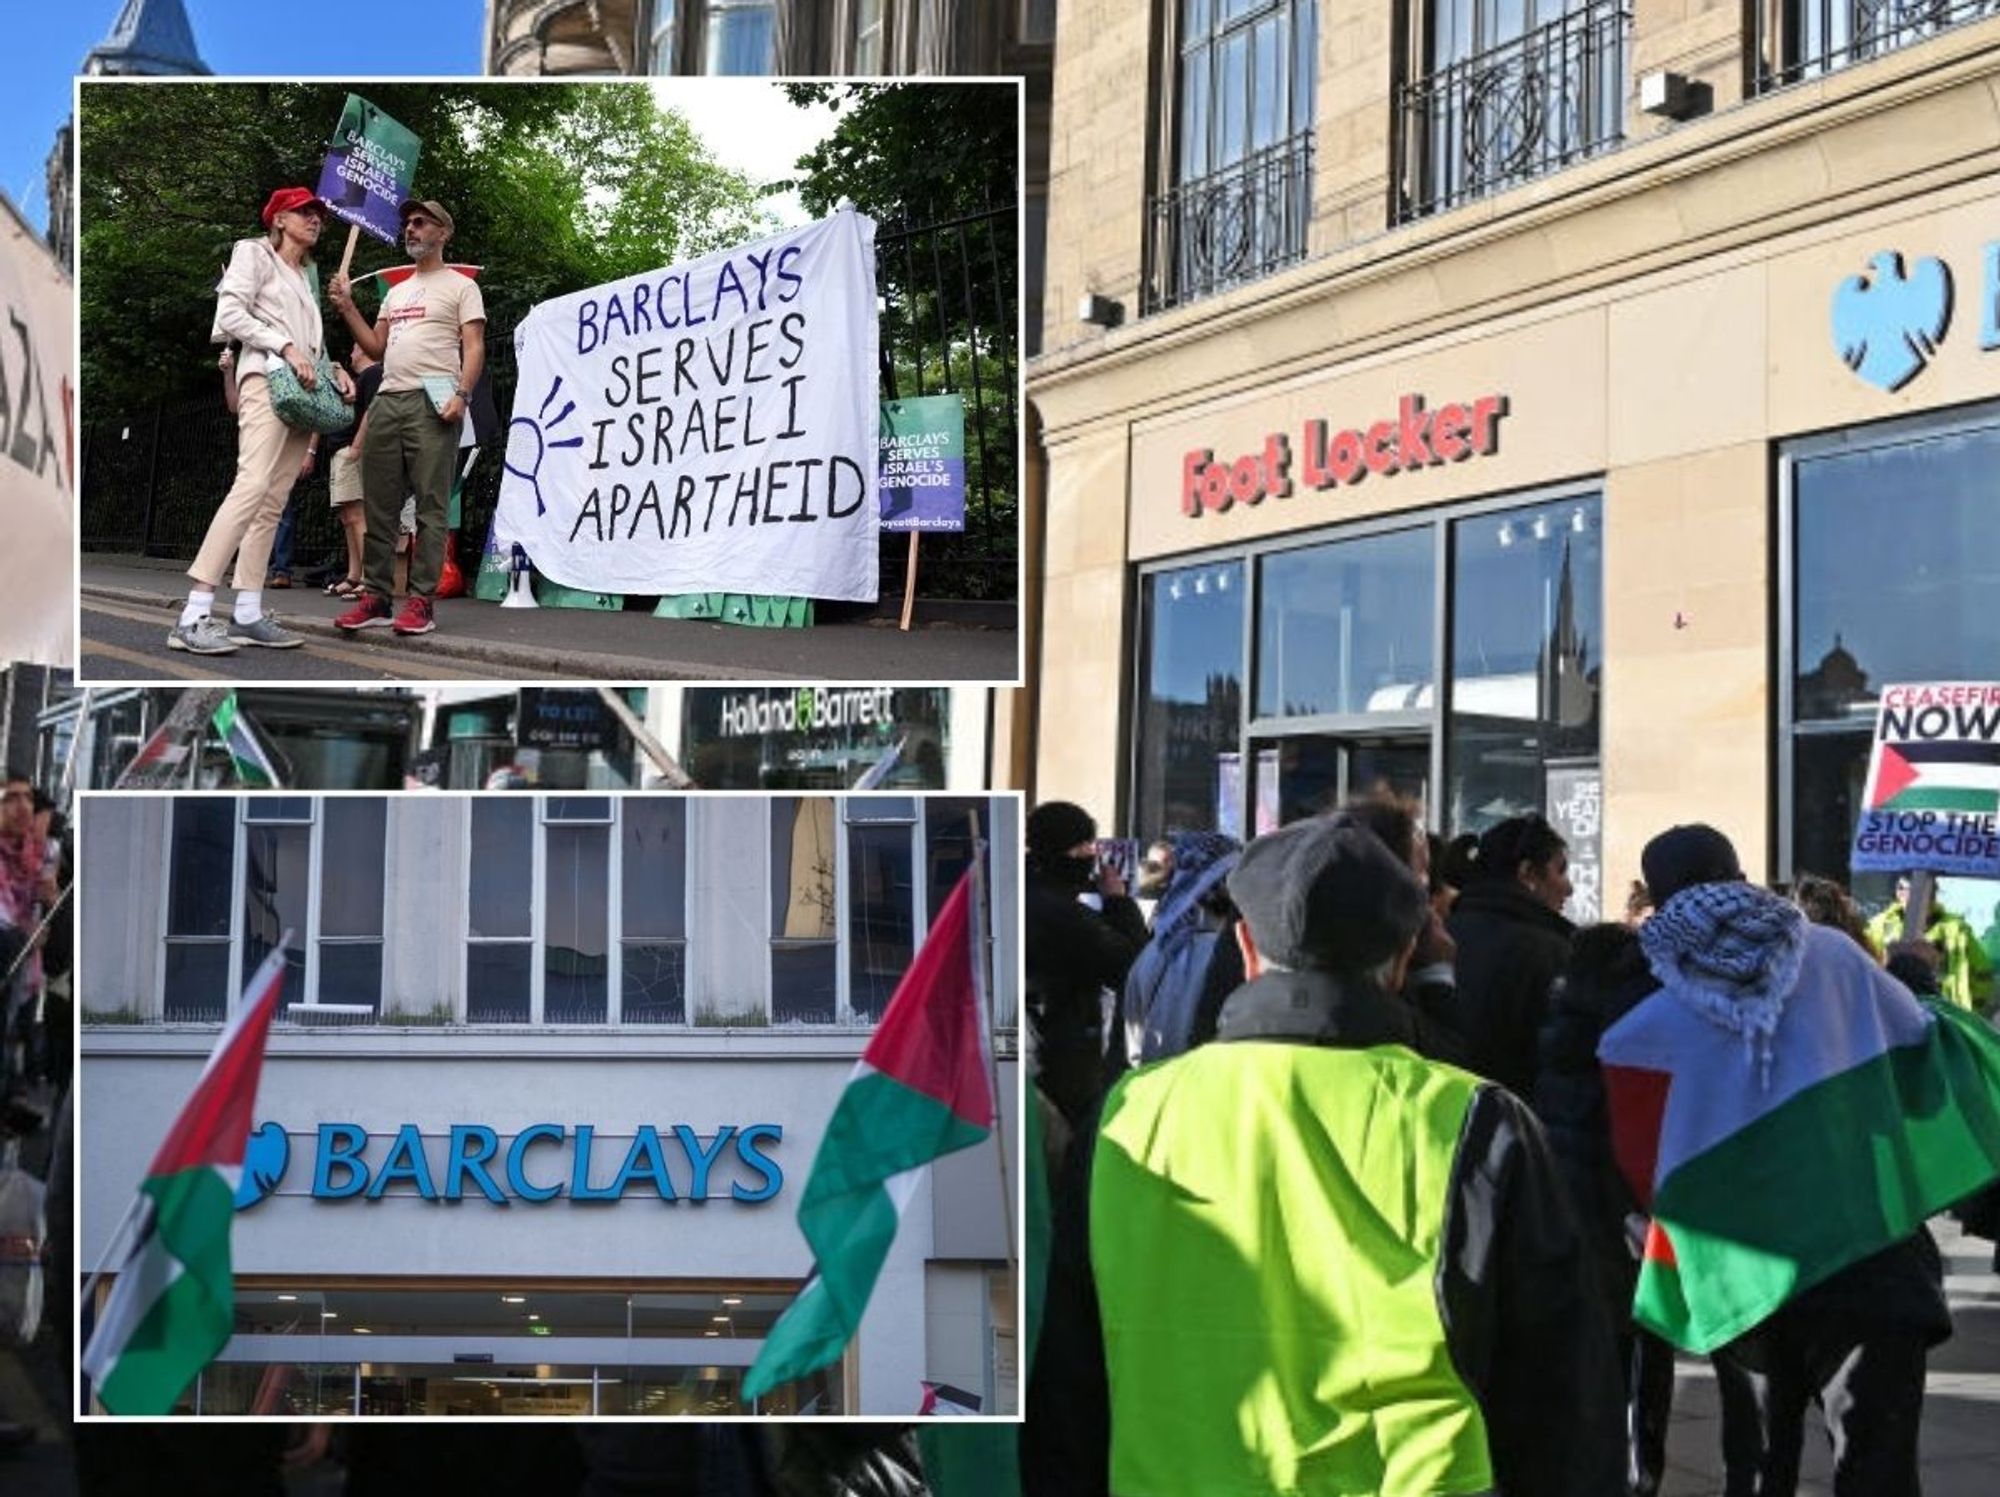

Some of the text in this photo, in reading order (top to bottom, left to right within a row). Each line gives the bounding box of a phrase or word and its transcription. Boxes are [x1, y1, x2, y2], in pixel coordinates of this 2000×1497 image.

[346, 129, 406, 171] BARCLAYS
[351, 145, 396, 178] SERVES
[336, 164, 399, 206] GENOCIDE
[344, 155, 397, 191] ISRAEL'S
[577, 246, 803, 355] BARCLAYS
[604, 312, 806, 408] SERVES
[588, 375, 807, 470] ISRAELI
[880, 432, 949, 449] BARCLAYS
[883, 460, 945, 475] ISRAEL'S
[888, 446, 940, 462] SERVES
[1182, 393, 1511, 518] Foot Locker
[569, 455, 866, 543] APARTHEID
[880, 473, 951, 488] GENOCIDE
[879, 517, 961, 529] oycottBarclays
[720, 690, 796, 737] Holland
[812, 687, 894, 729] Barrett
[1880, 704, 2000, 741] NOW
[1866, 812, 1996, 835] STOP THE
[1857, 834, 2000, 858] GENOCIDE
[312, 1123, 783, 1205] BARCLAYS
